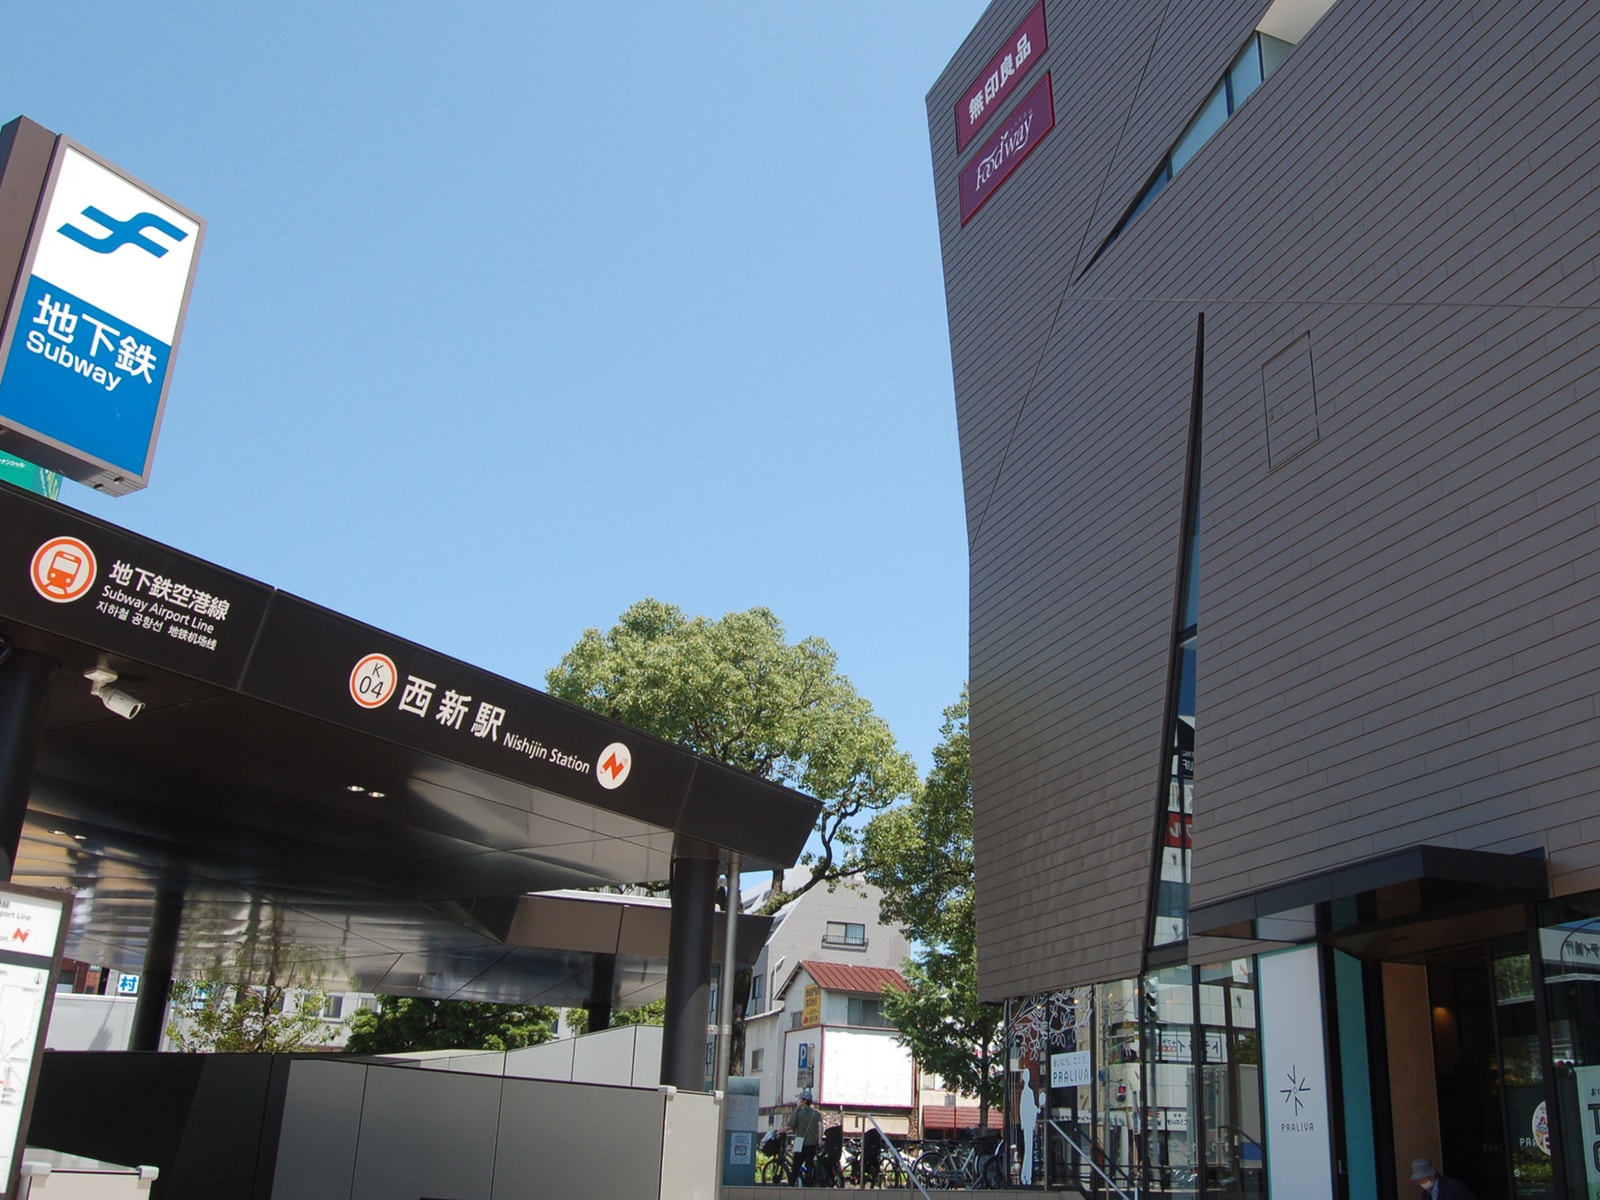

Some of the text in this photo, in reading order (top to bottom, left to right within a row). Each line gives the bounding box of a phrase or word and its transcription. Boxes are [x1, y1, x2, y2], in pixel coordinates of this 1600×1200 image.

[969, 33, 1031, 125] 無印良品
[975, 114, 1033, 192] Foodway
[26, 330, 121, 391] Subway
[33, 293, 157, 385] 地下鉄
[101, 585, 214, 634] Subway Airport Line
[109, 560, 230, 621] 地下鉄空港線
[96, 601, 217, 651] 지하철 공항선 地铁机场线
[359, 675, 384, 699] 04
[372, 663, 384, 678] K
[398, 674, 506, 742] 西新駅
[503, 732, 590, 774] Nishijin Station
[17, 912, 31, 921] Line
[120, 976, 137, 992] 村
[800, 1046, 807, 1065] P
[1053, 1068, 1089, 1083] PRALIVA
[1281, 1122, 1314, 1133] PRALIVA
